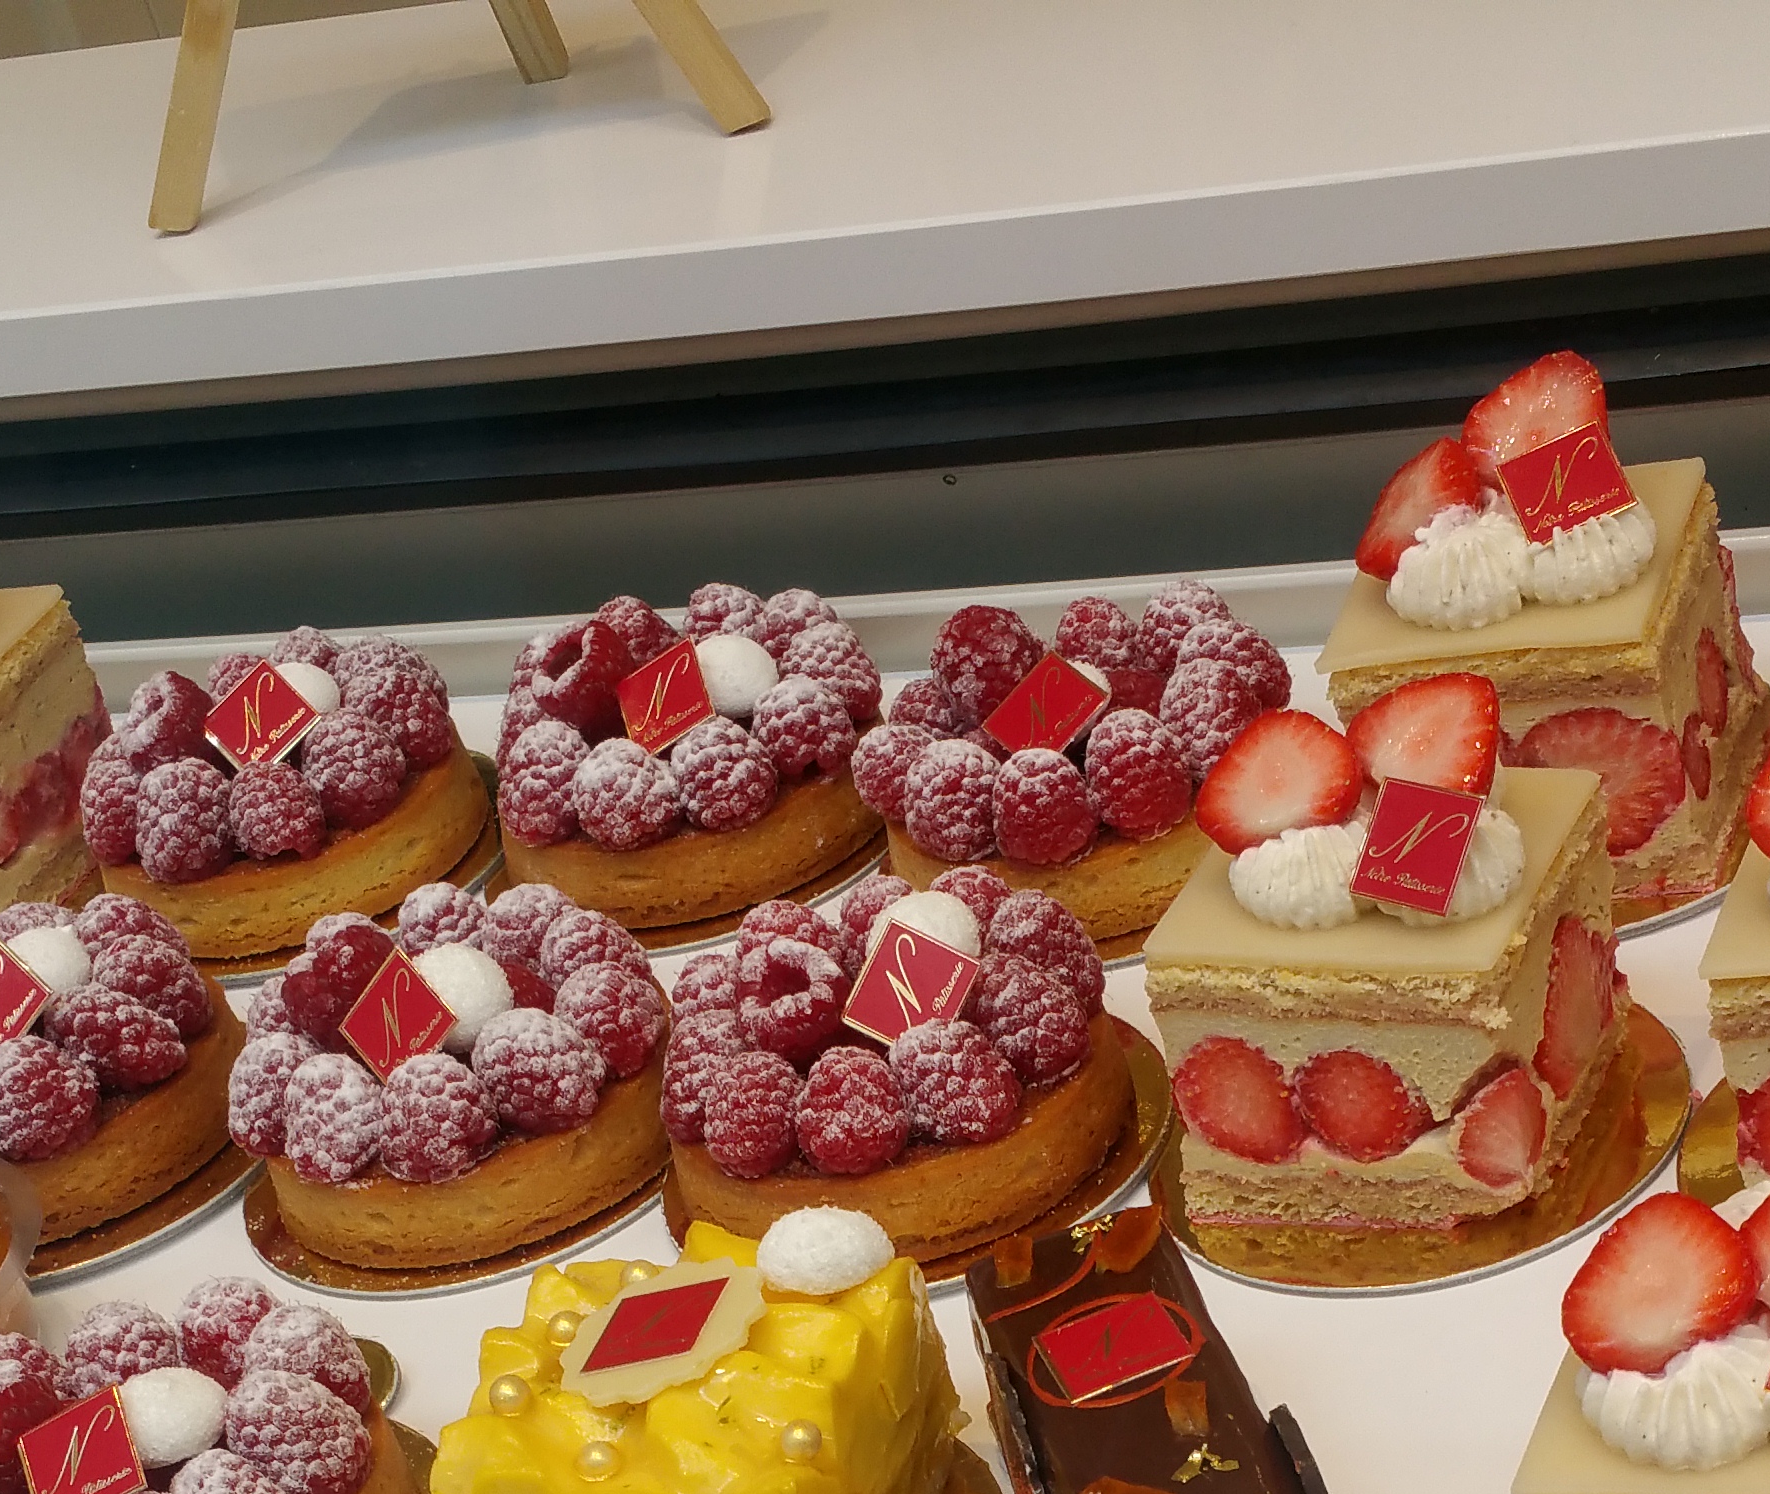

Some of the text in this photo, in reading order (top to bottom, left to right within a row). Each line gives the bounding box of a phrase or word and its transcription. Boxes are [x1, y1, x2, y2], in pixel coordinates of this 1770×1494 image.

[1525, 436, 1599, 517] N
[236, 672, 274, 755] N
[634, 652, 690, 732] N
[1369, 813, 1470, 863] N
[379, 967, 410, 1068] N
